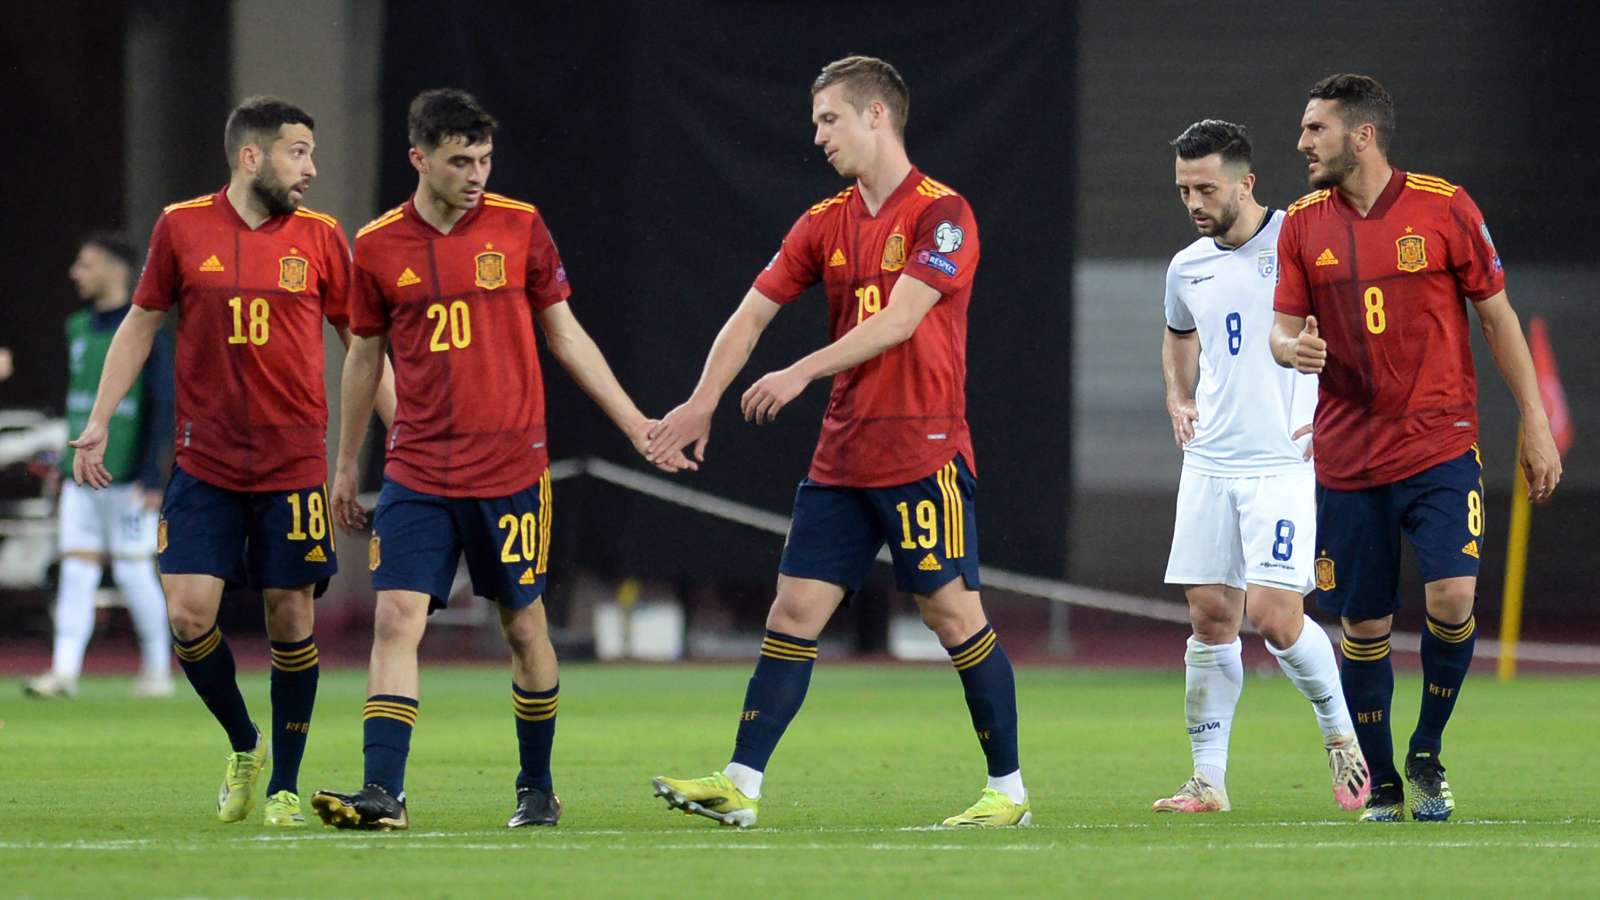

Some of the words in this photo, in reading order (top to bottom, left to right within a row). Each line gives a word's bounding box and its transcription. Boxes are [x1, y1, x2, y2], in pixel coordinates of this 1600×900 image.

[929, 255, 957, 275] RESPECT
[228, 297, 270, 345] 18
[426, 301, 471, 352] 20
[1226, 312, 1241, 355] 8
[1364, 286, 1386, 334] 8
[287, 491, 326, 540] 18
[896, 500, 937, 549] 19
[1467, 490, 1481, 536] 8
[498, 512, 536, 563] 20
[1272, 519, 1295, 561] 8
